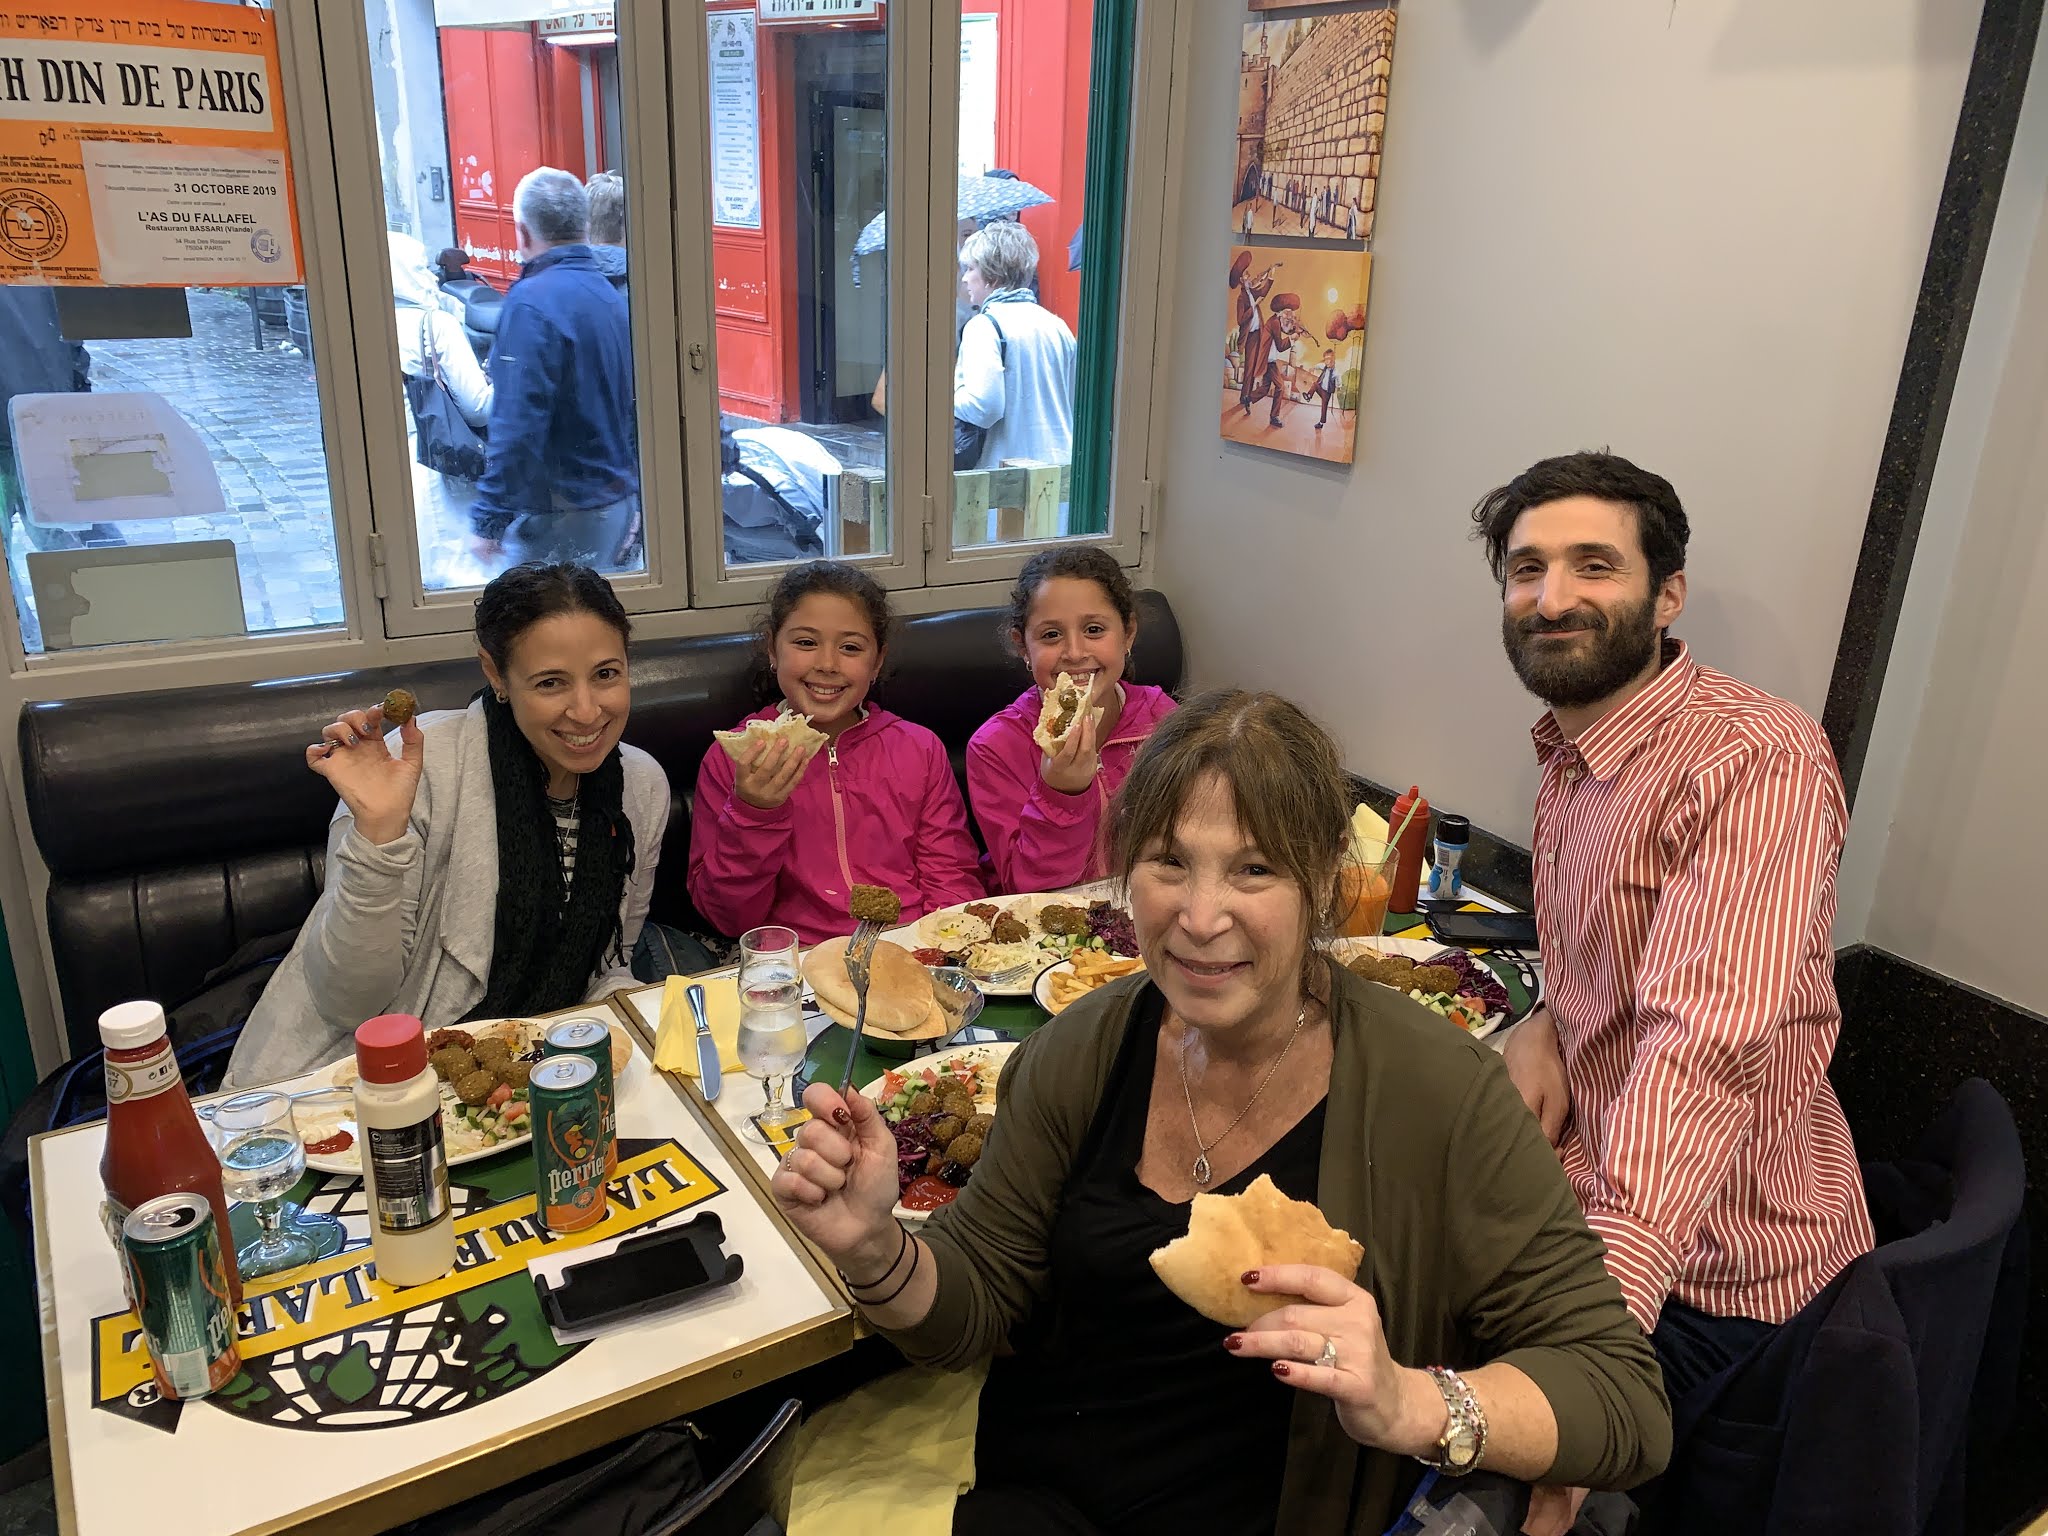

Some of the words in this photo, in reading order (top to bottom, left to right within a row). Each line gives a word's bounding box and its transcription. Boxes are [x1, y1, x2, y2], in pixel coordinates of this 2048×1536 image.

[138, 21, 161, 37] בית
[166, 18, 185, 39] של
[0, 57, 30, 101] H
[37, 58, 106, 105] DIN
[116, 62, 165, 108] DE
[172, 66, 265, 115] PARIS
[174, 183, 187, 193] 31
[191, 184, 250, 195] OCTOBRE
[253, 186, 277, 196] 2019
[138, 211, 168, 222] L'AS
[172, 212, 190, 223] DU
[194, 213, 257, 224] FALLAFEL
[145, 224, 188, 232] Restaurant
[225, 226, 254, 234] (Viande)
[600, 1157, 697, 1223] L'A
